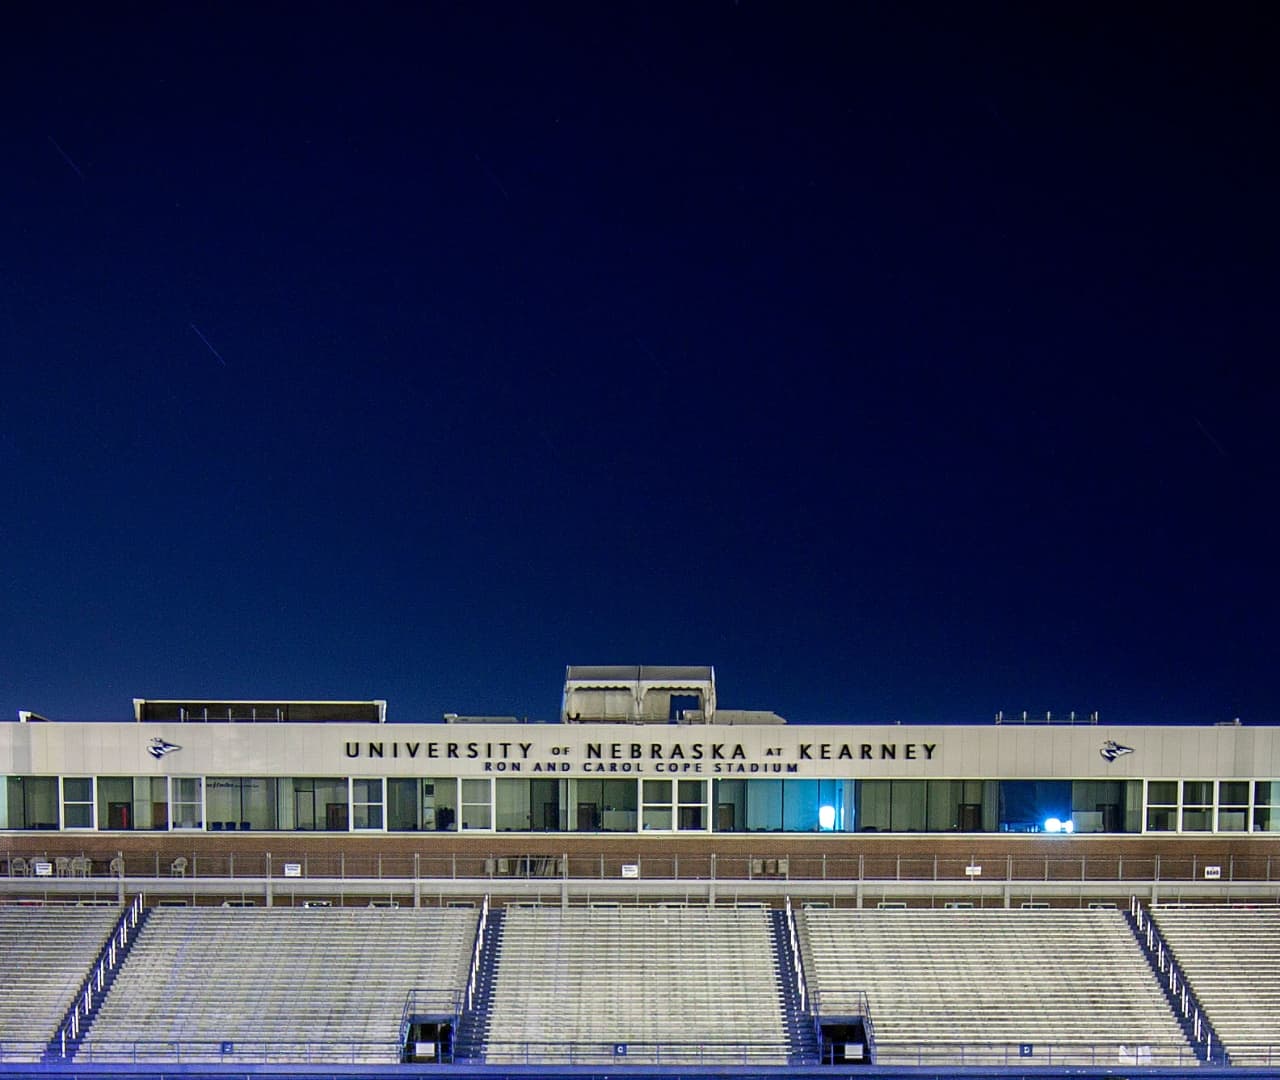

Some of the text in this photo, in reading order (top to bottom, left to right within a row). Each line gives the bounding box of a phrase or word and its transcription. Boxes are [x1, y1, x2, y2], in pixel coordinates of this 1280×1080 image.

[346, 742, 937, 760] UNIVERSITY OF NEBRASKA AT KEARNEY
[485, 762, 798, 773] RON AND CAROL COPE STADIUM
